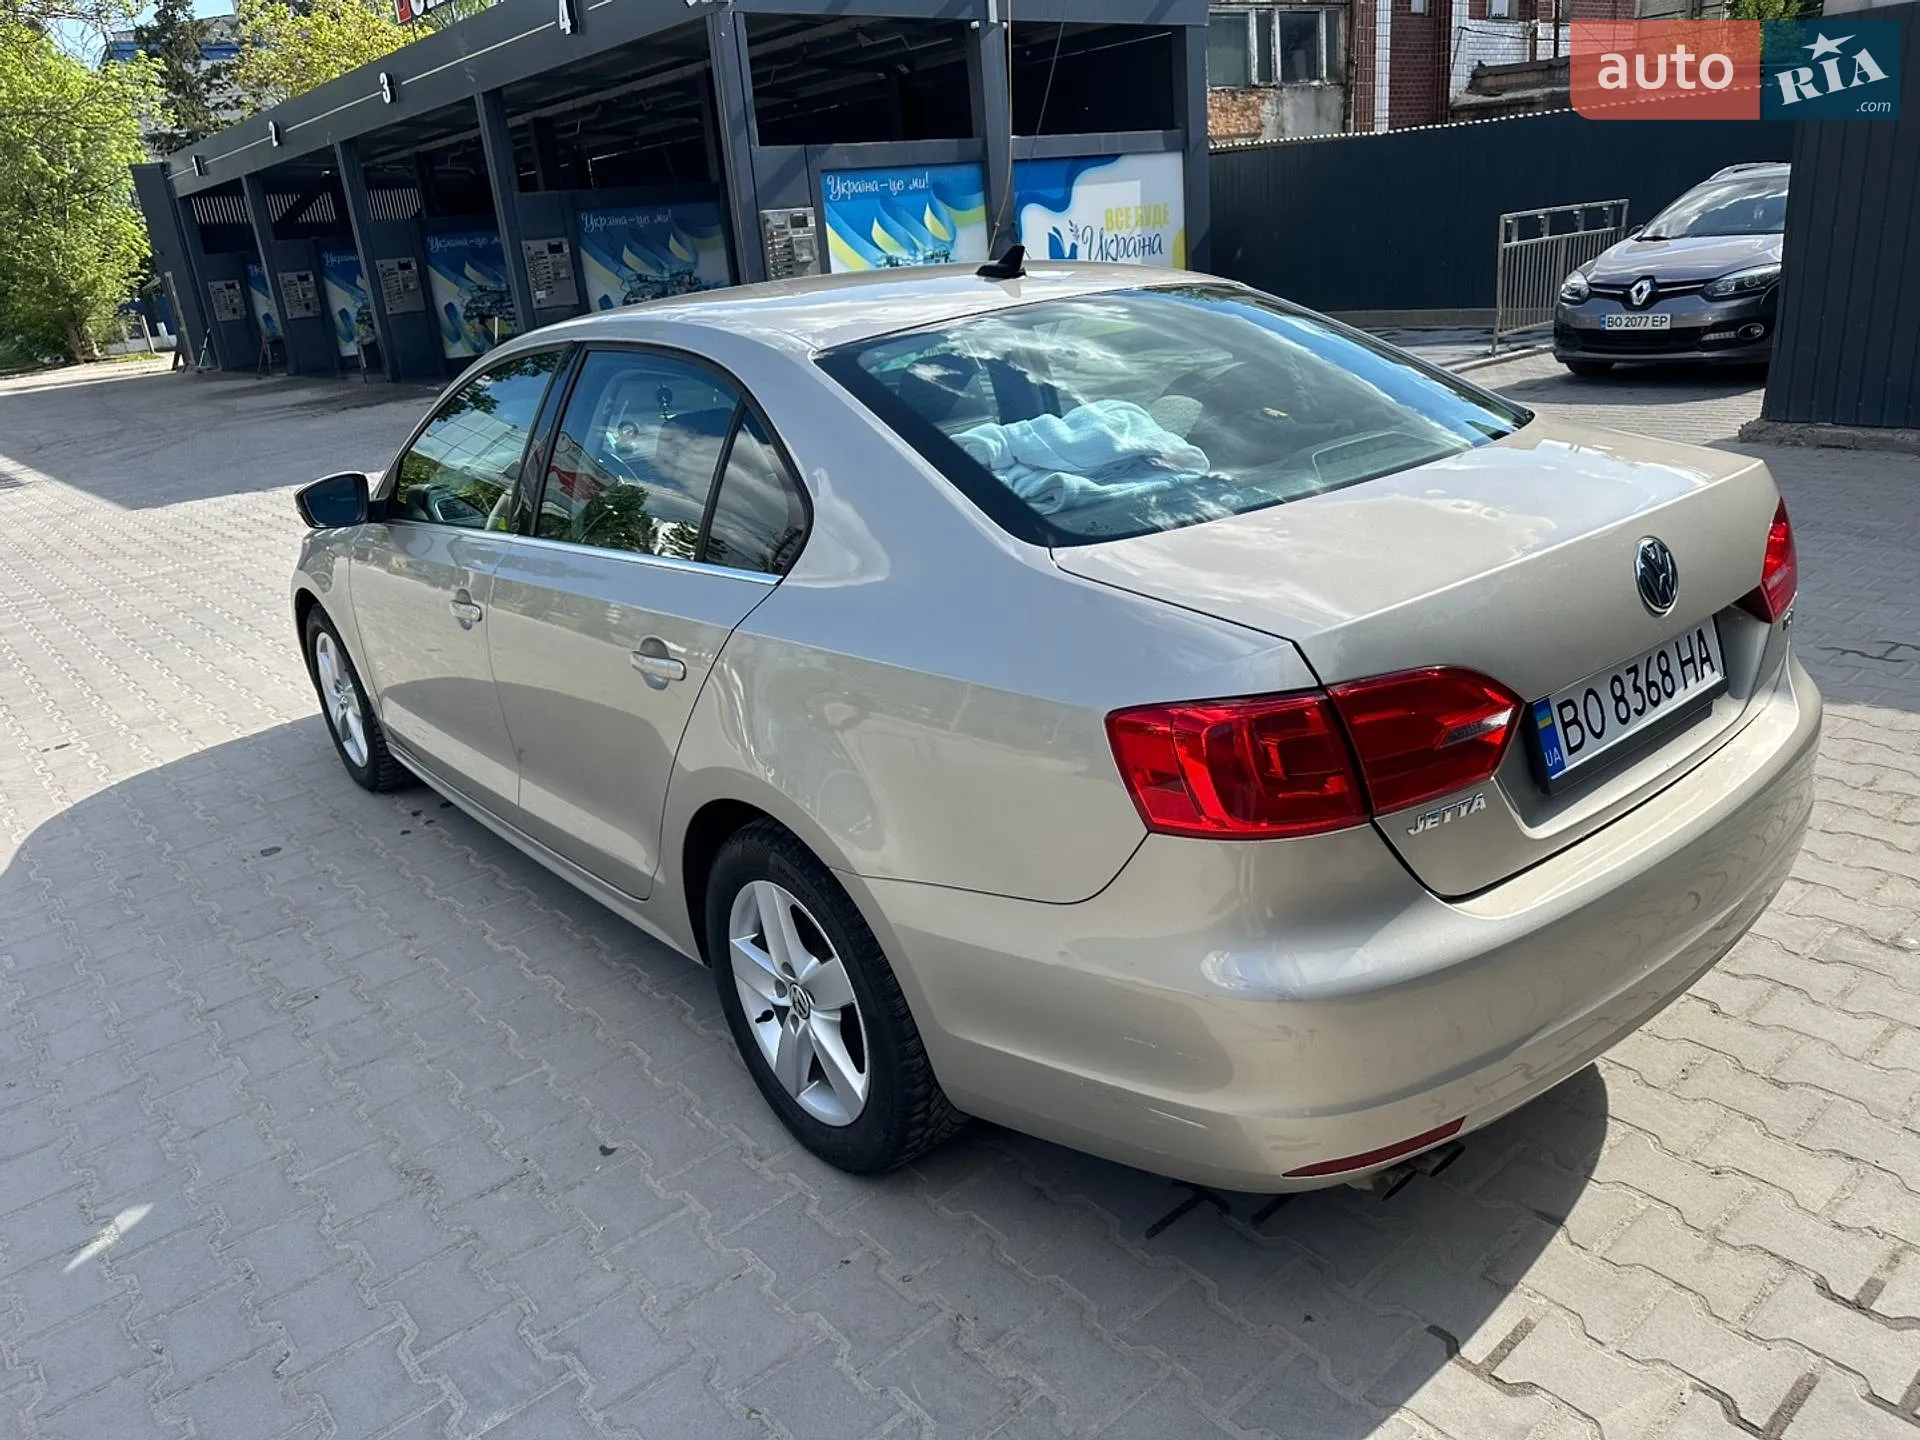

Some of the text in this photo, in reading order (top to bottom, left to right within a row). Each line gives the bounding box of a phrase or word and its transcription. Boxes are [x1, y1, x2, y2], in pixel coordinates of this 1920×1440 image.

[558, 0, 572, 35] 4
[379, 72, 394, 104] 3
[908, 171, 929, 190] ми!
[1104, 203, 1169, 231] ВСЕ БУДЕ
[1082, 225, 1163, 262] Україна
[1624, 316, 1649, 328] 2077
[1651, 315, 1668, 328] EP
[1556, 628, 1716, 757] BO 8368 HA
[1545, 746, 1563, 768] UA
[1407, 792, 1487, 836] JETTA
